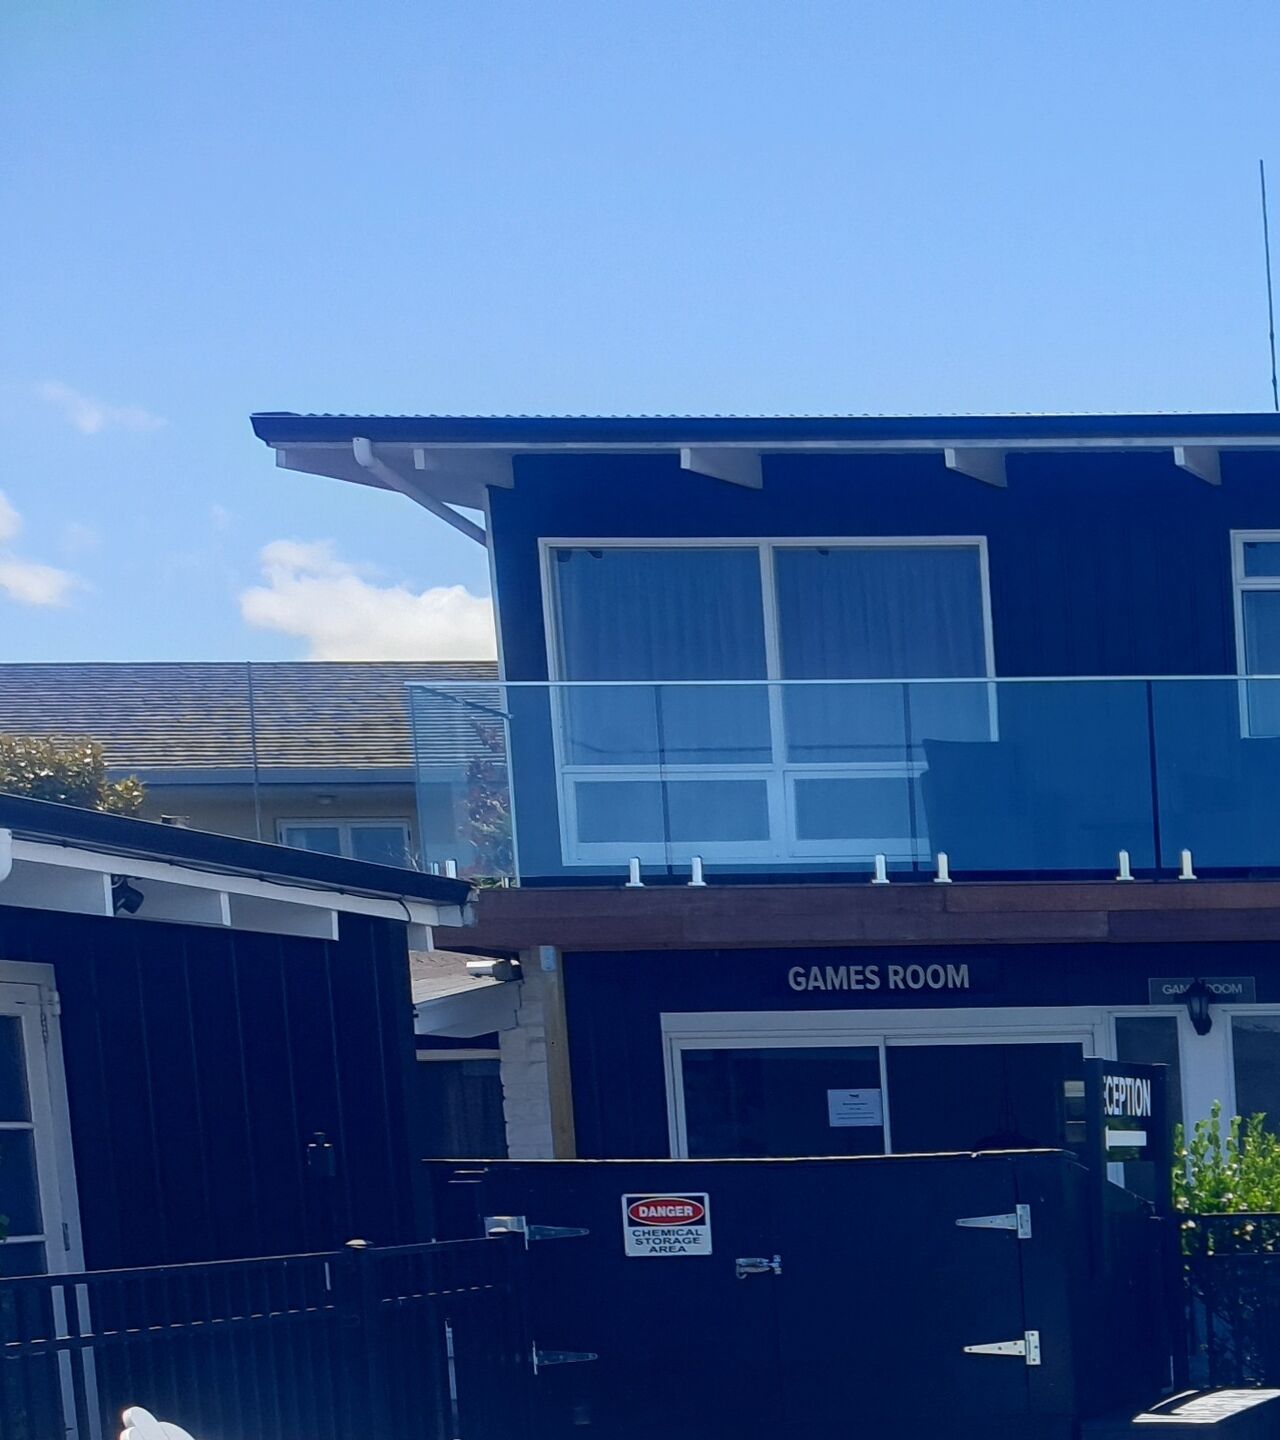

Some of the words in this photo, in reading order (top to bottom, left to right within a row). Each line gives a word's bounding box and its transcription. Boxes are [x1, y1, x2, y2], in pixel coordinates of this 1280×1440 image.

[788, 965, 881, 991] GAMES
[888, 964, 970, 989] ROOM
[1162, 984, 1191, 995] GAM
[1103, 1075, 1152, 1117] CEPTION
[638, 1205, 693, 1217] DANGER
[632, 1228, 704, 1237] CHEMICAL
[635, 1237, 702, 1245] STORAGE
[649, 1245, 687, 1254] AREA
